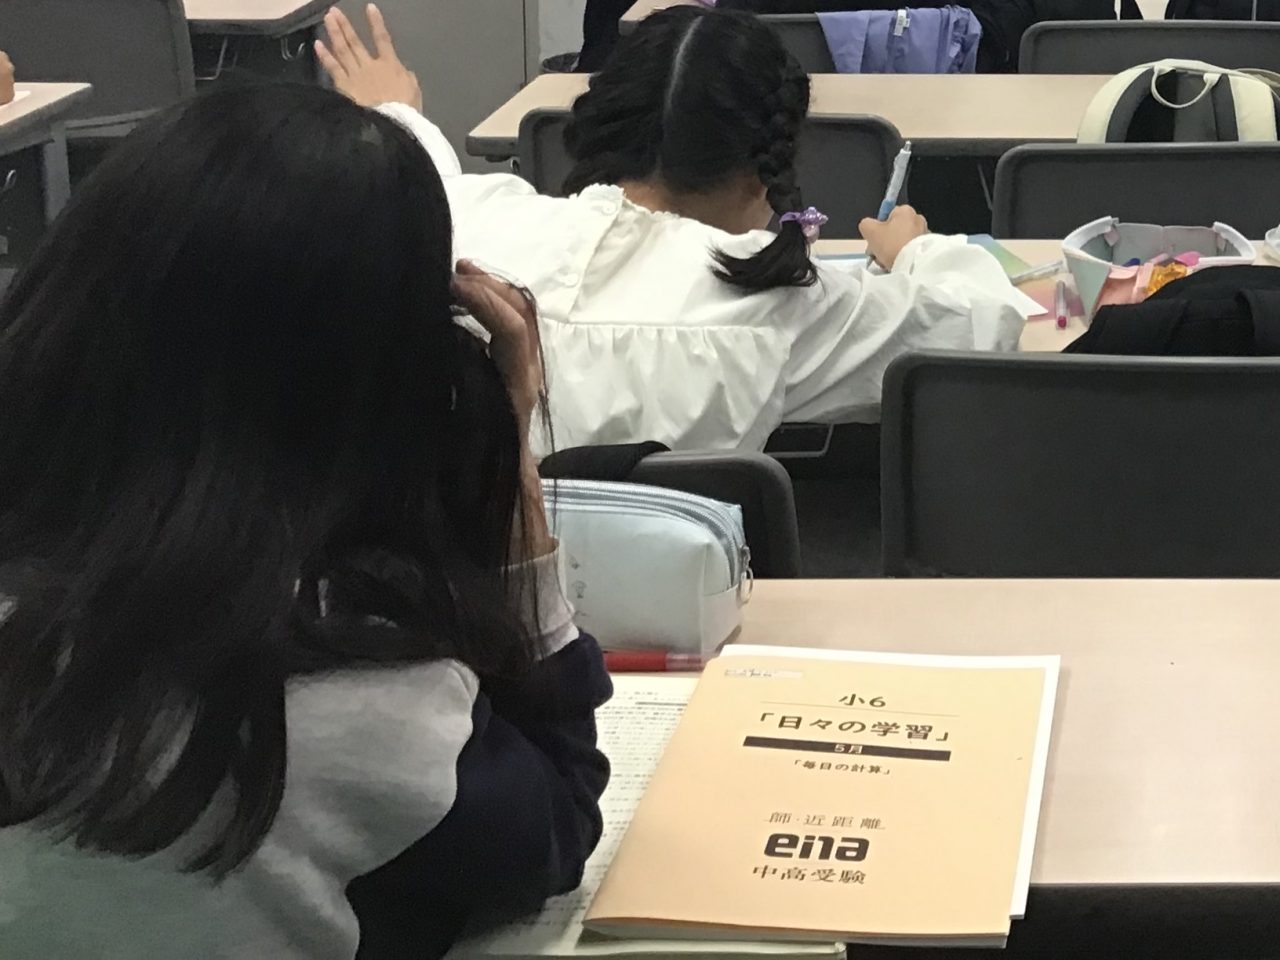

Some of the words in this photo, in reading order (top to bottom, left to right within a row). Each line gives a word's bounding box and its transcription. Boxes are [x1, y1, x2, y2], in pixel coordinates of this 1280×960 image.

[838, 693, 887, 708] 小6
[760, 712, 949, 742] 「日々の学習」
[834, 743, 863, 754] 5月
[763, 832, 870, 862] ena
[752, 864, 866, 884] 中高受験
